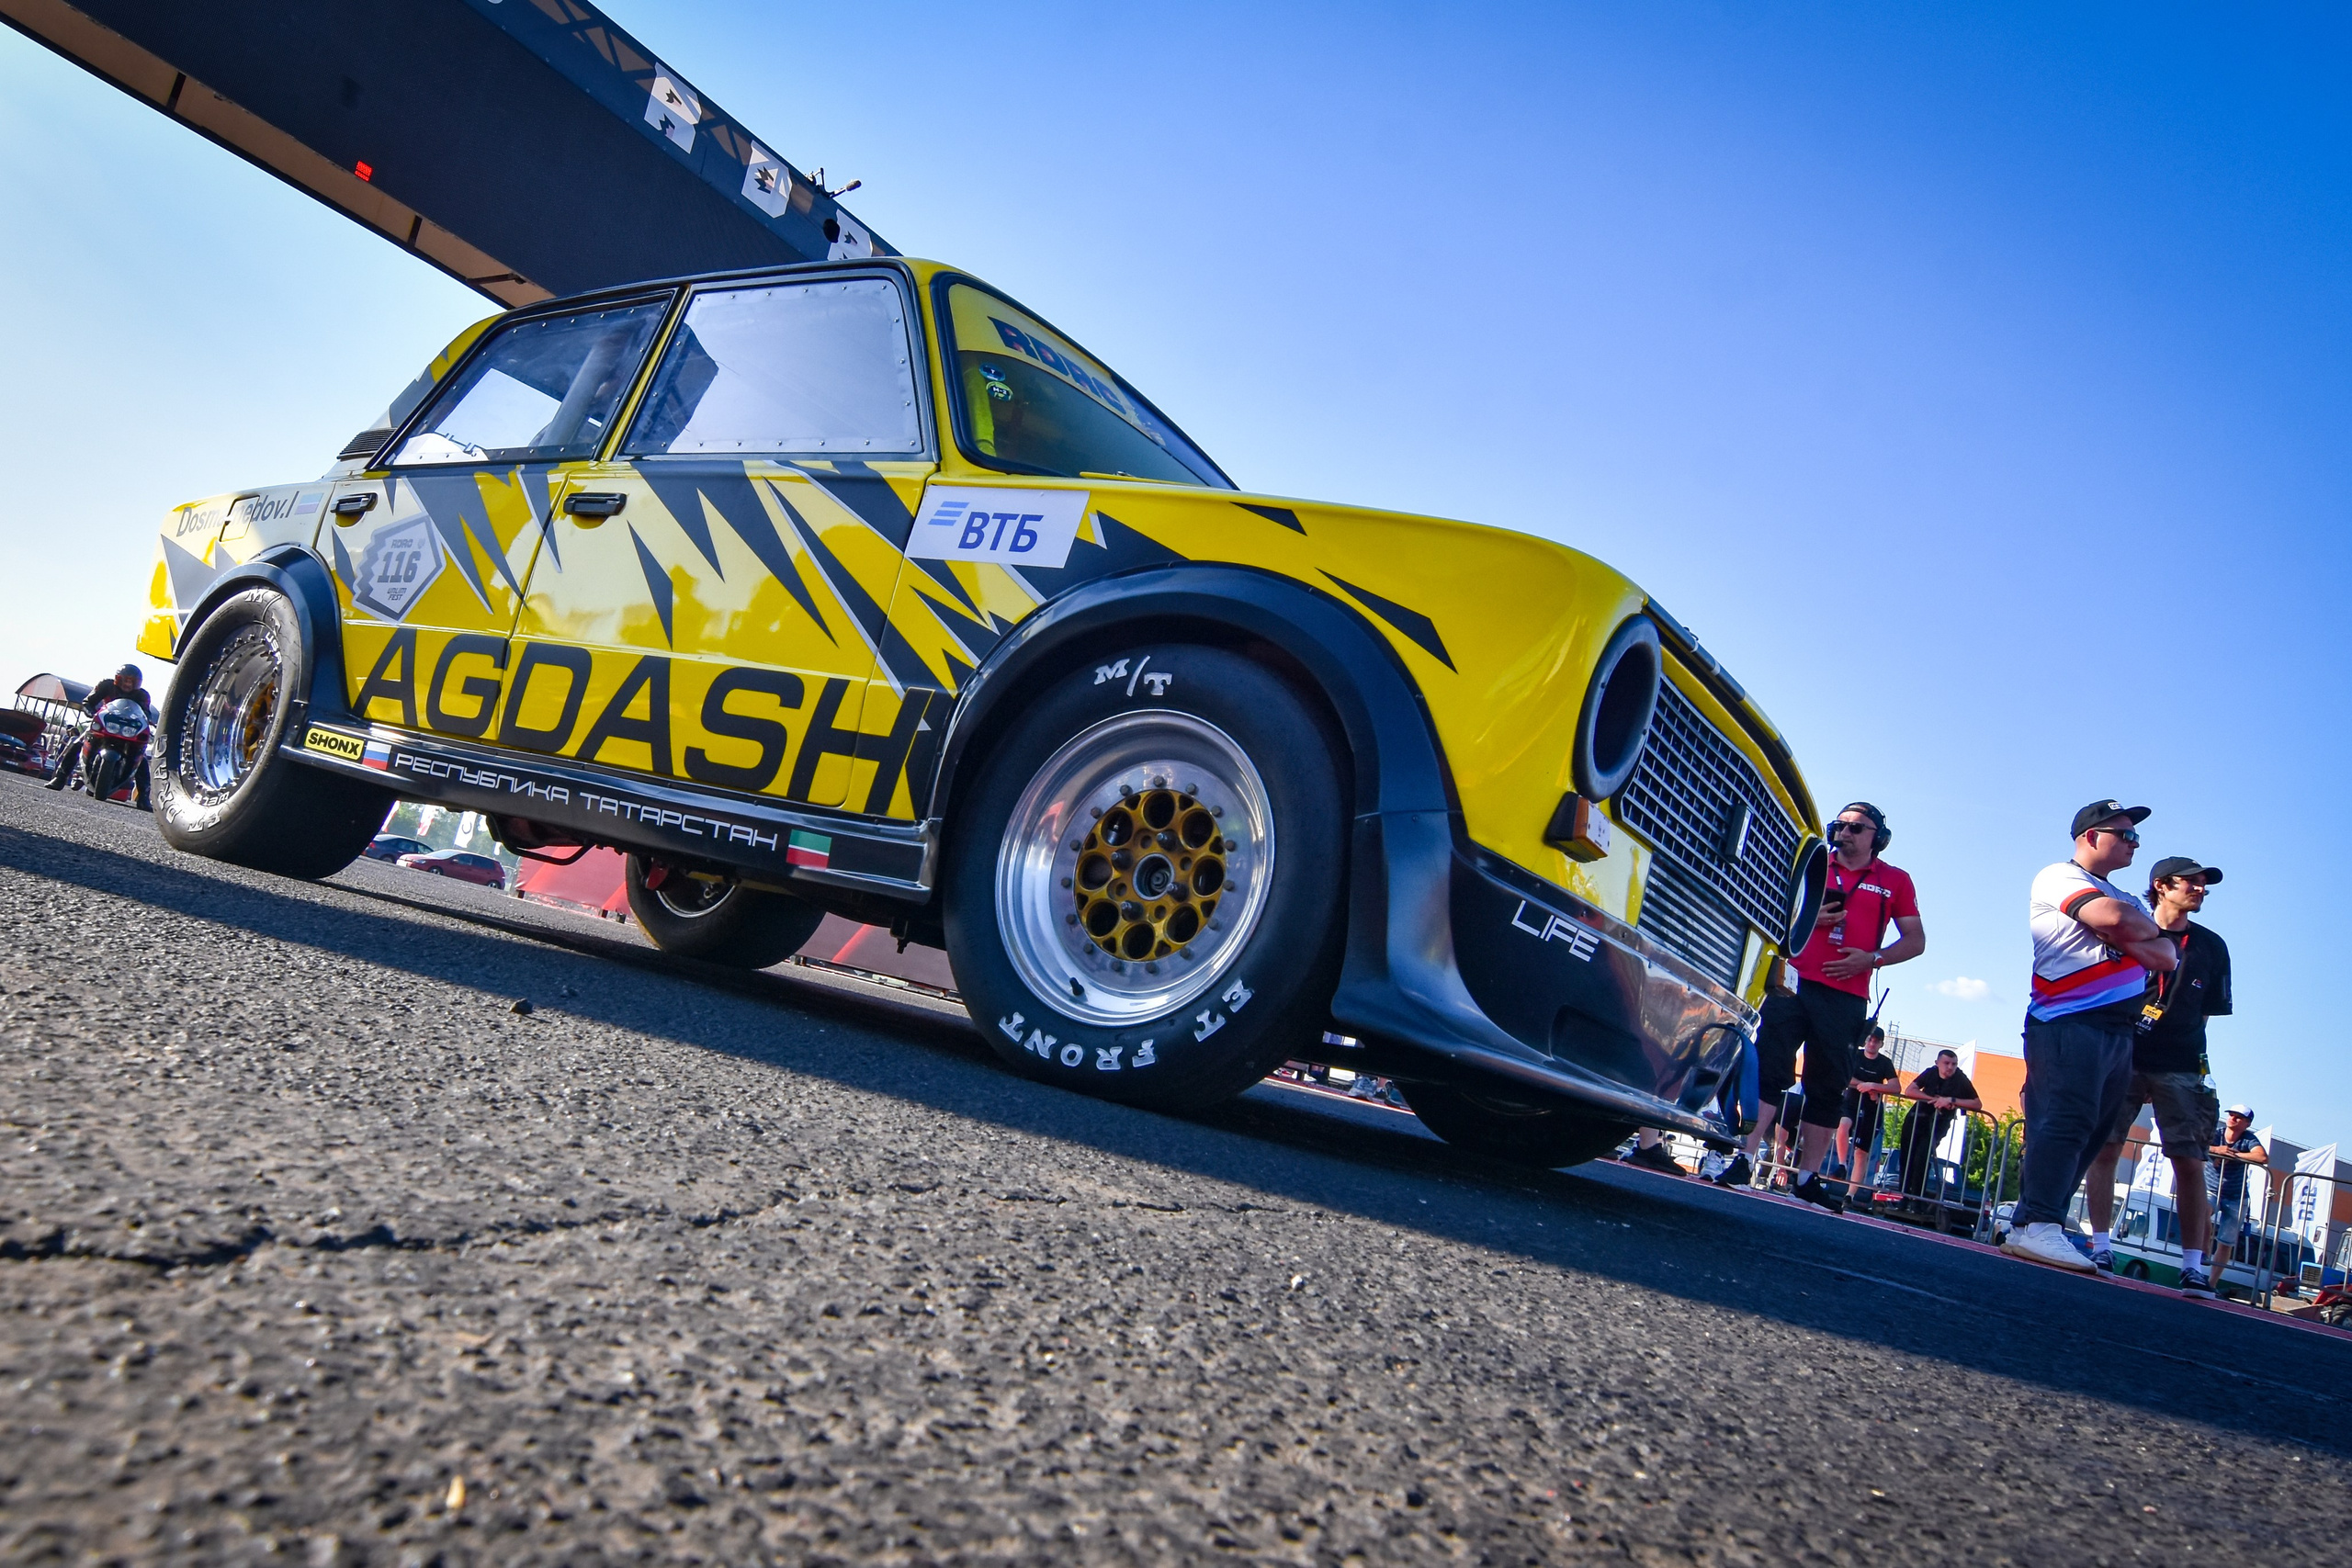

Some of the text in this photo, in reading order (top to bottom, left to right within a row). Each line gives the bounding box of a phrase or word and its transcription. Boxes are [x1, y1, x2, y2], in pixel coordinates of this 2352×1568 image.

[958, 512, 1044, 553] ВТБ
[377, 551, 422, 583] 116
[1093, 655, 1173, 697] M/T
[308, 732, 361, 756] SHONX
[351, 627, 935, 817] AGDASH
[395, 752, 778, 852] РЕСПУБЛИКА ТАТАРСТАН
[1511, 899, 1600, 963] LIFE
[999, 979, 1253, 1071] ET FRONT
